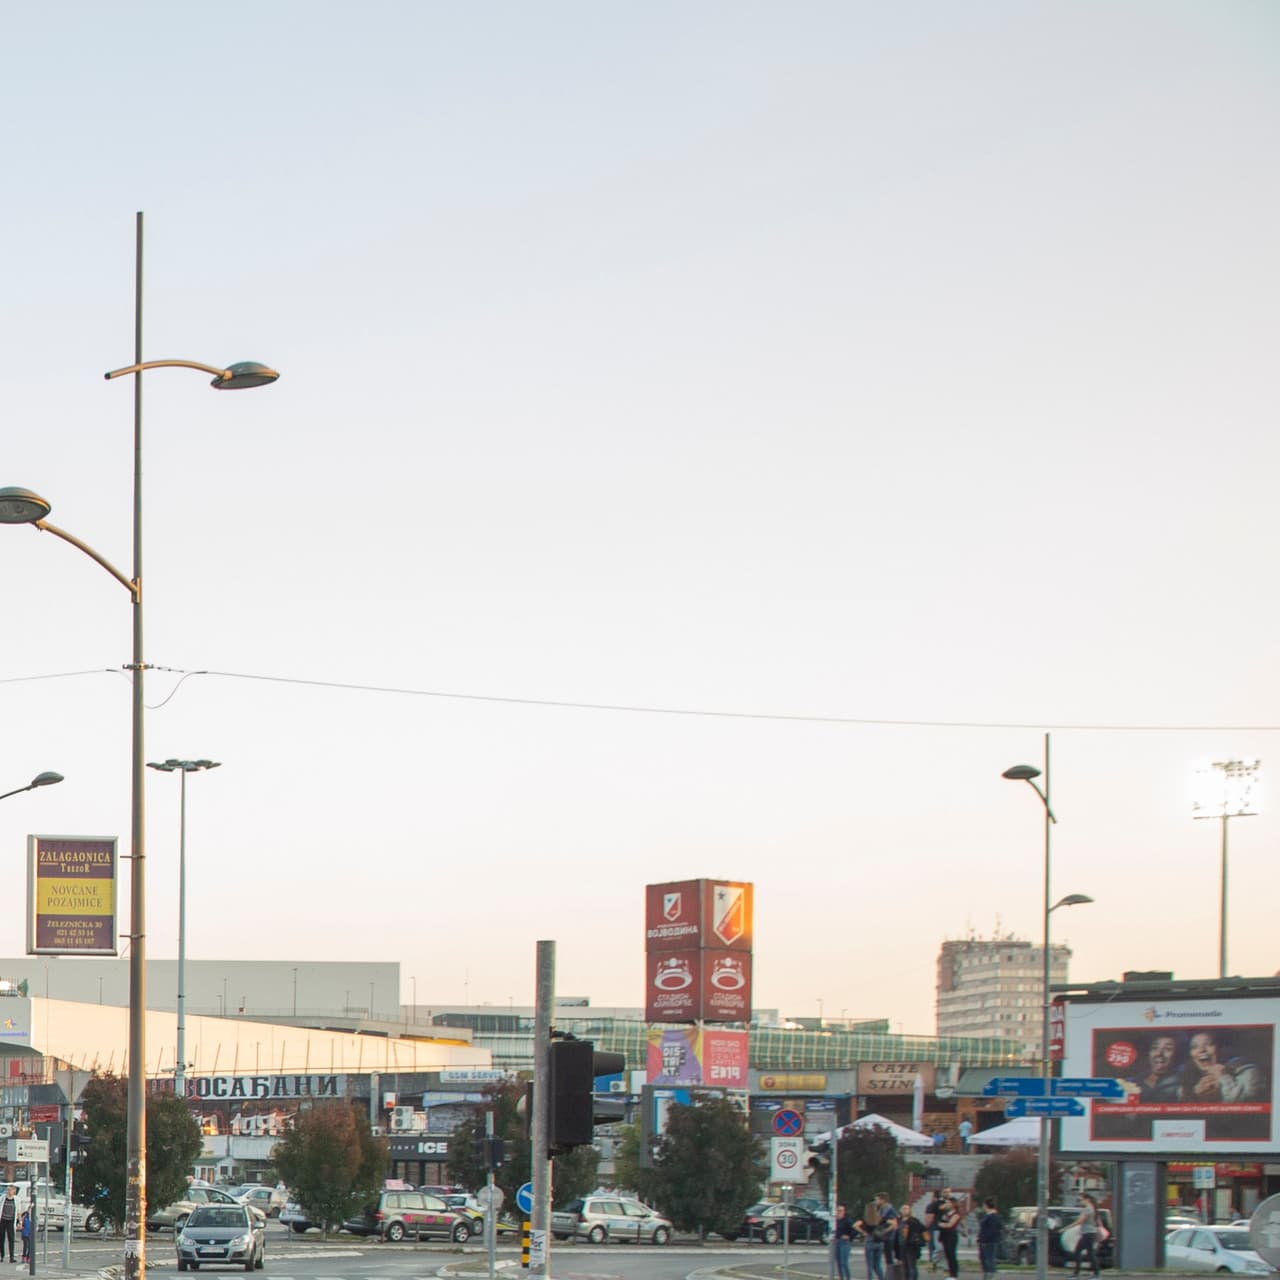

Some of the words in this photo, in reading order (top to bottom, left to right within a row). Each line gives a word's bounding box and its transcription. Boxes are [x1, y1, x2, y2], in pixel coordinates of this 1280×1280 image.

[39, 851, 111, 862] ZALAGAONICA
[47, 897, 103, 909] POZAJMICE
[868, 1079, 917, 1089] STIN
[417, 1142, 448, 1154] ICE
